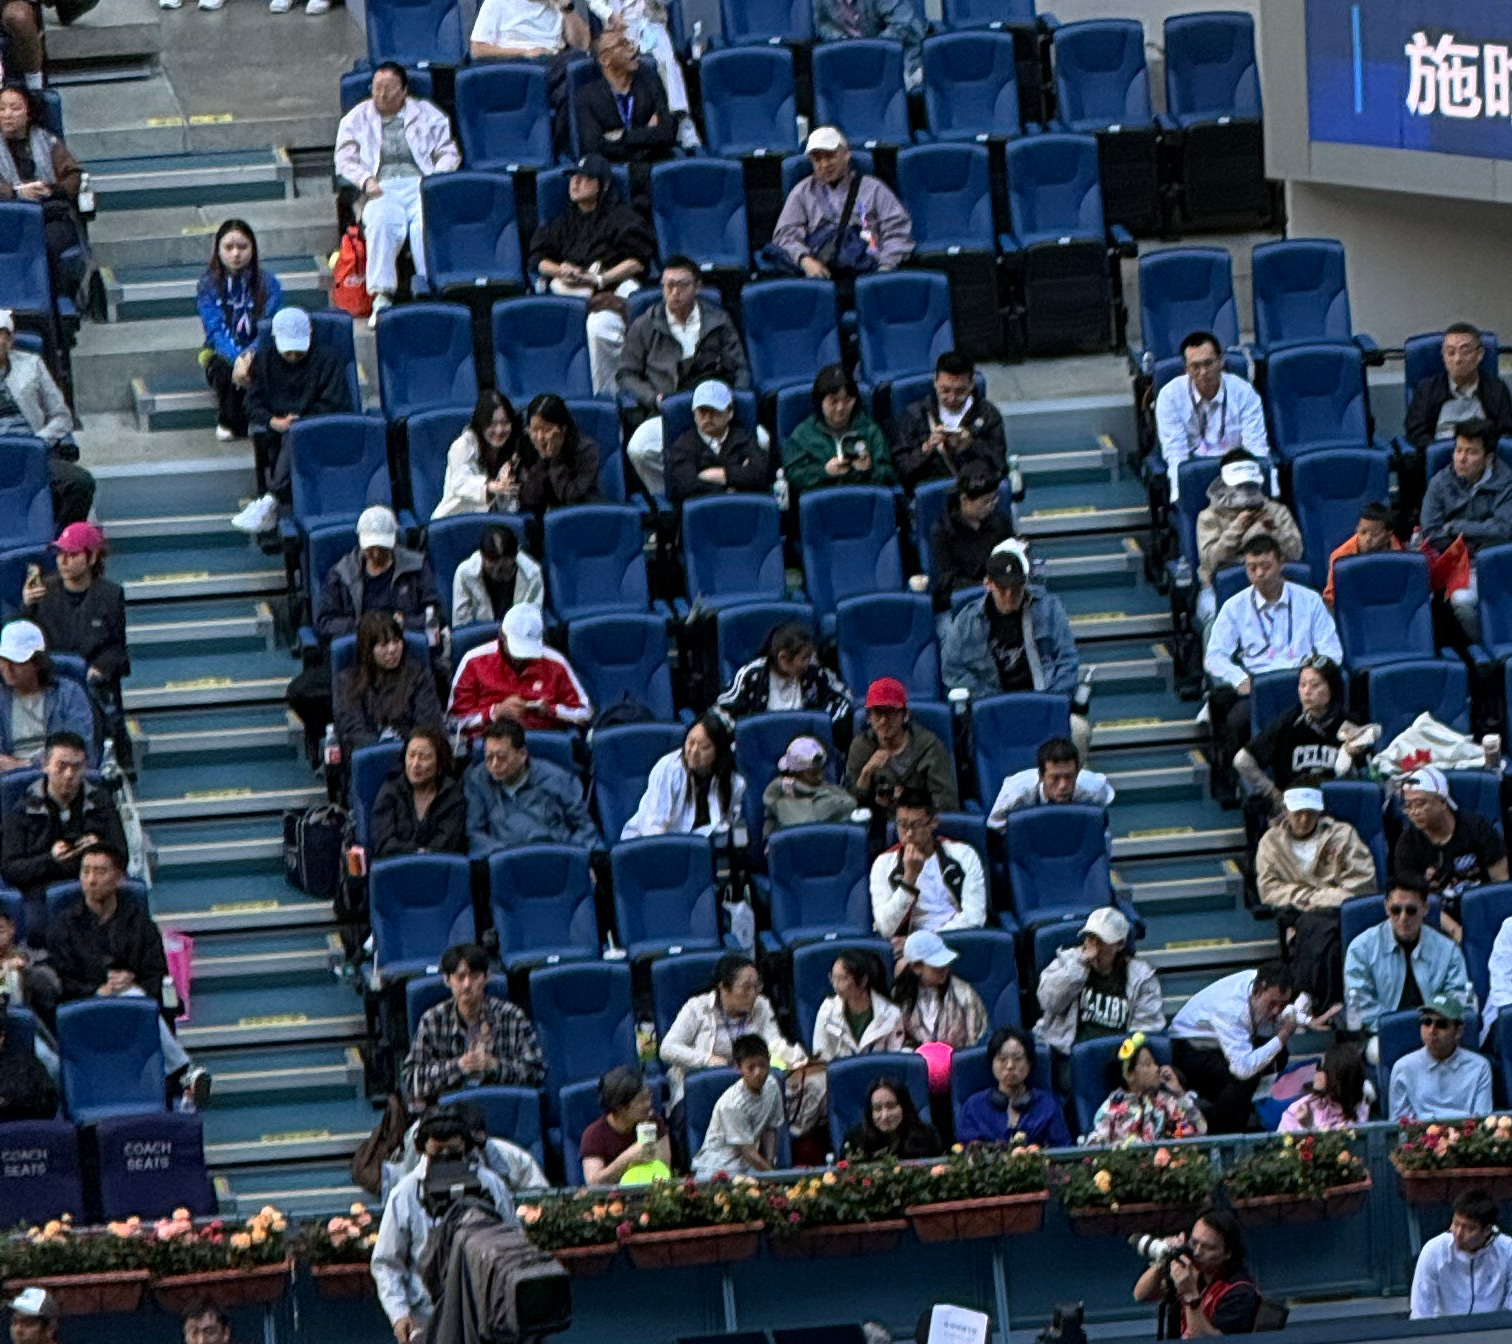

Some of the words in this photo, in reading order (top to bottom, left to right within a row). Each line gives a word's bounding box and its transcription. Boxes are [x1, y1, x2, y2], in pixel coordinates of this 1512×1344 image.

[1292, 744, 1340, 772] CELIN
[124, 1141, 172, 1156] COACH
[127, 1156, 170, 1171] SEATS
